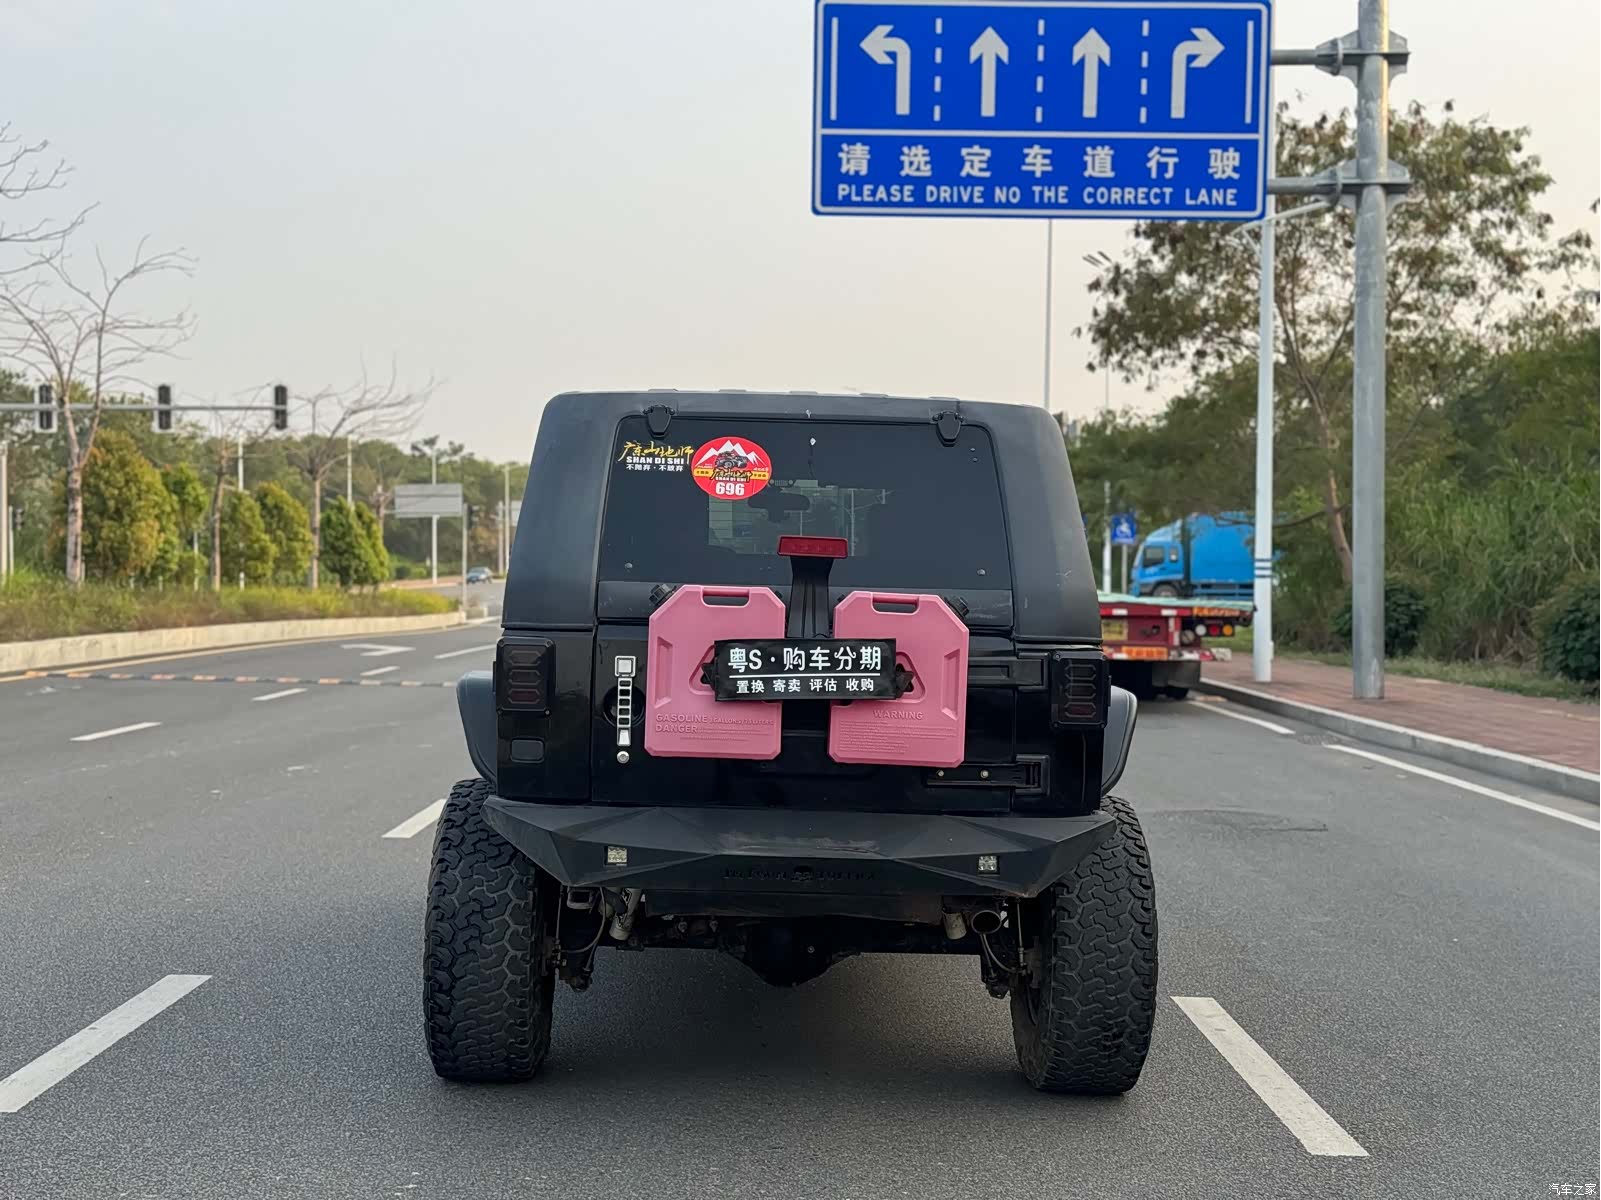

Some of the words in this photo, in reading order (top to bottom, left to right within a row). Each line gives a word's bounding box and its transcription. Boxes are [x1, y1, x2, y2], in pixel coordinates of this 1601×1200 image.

[838, 142, 1240, 180] 请选定车道行驶
[838, 183, 914, 202] PLEASE
[926, 185, 984, 203] DRIVE
[994, 186, 1021, 204] NO
[1032, 185, 1068, 204] THE
[1083, 187, 1173, 205] CORRECT
[1185, 188, 1237, 206] LANE
[626, 456, 653, 464] SHAN
[667, 457, 685, 465] SHI
[715, 482, 745, 496] 696
[736, 680, 765, 694] 置换
[772, 679, 801, 693] 寄卖
[809, 678, 837, 692] 评估
[846, 678, 874, 692] 收购
[655, 713, 708, 724] GASOLINE
[873, 709, 924, 720] WARNING
[655, 724, 698, 734] DANGER
